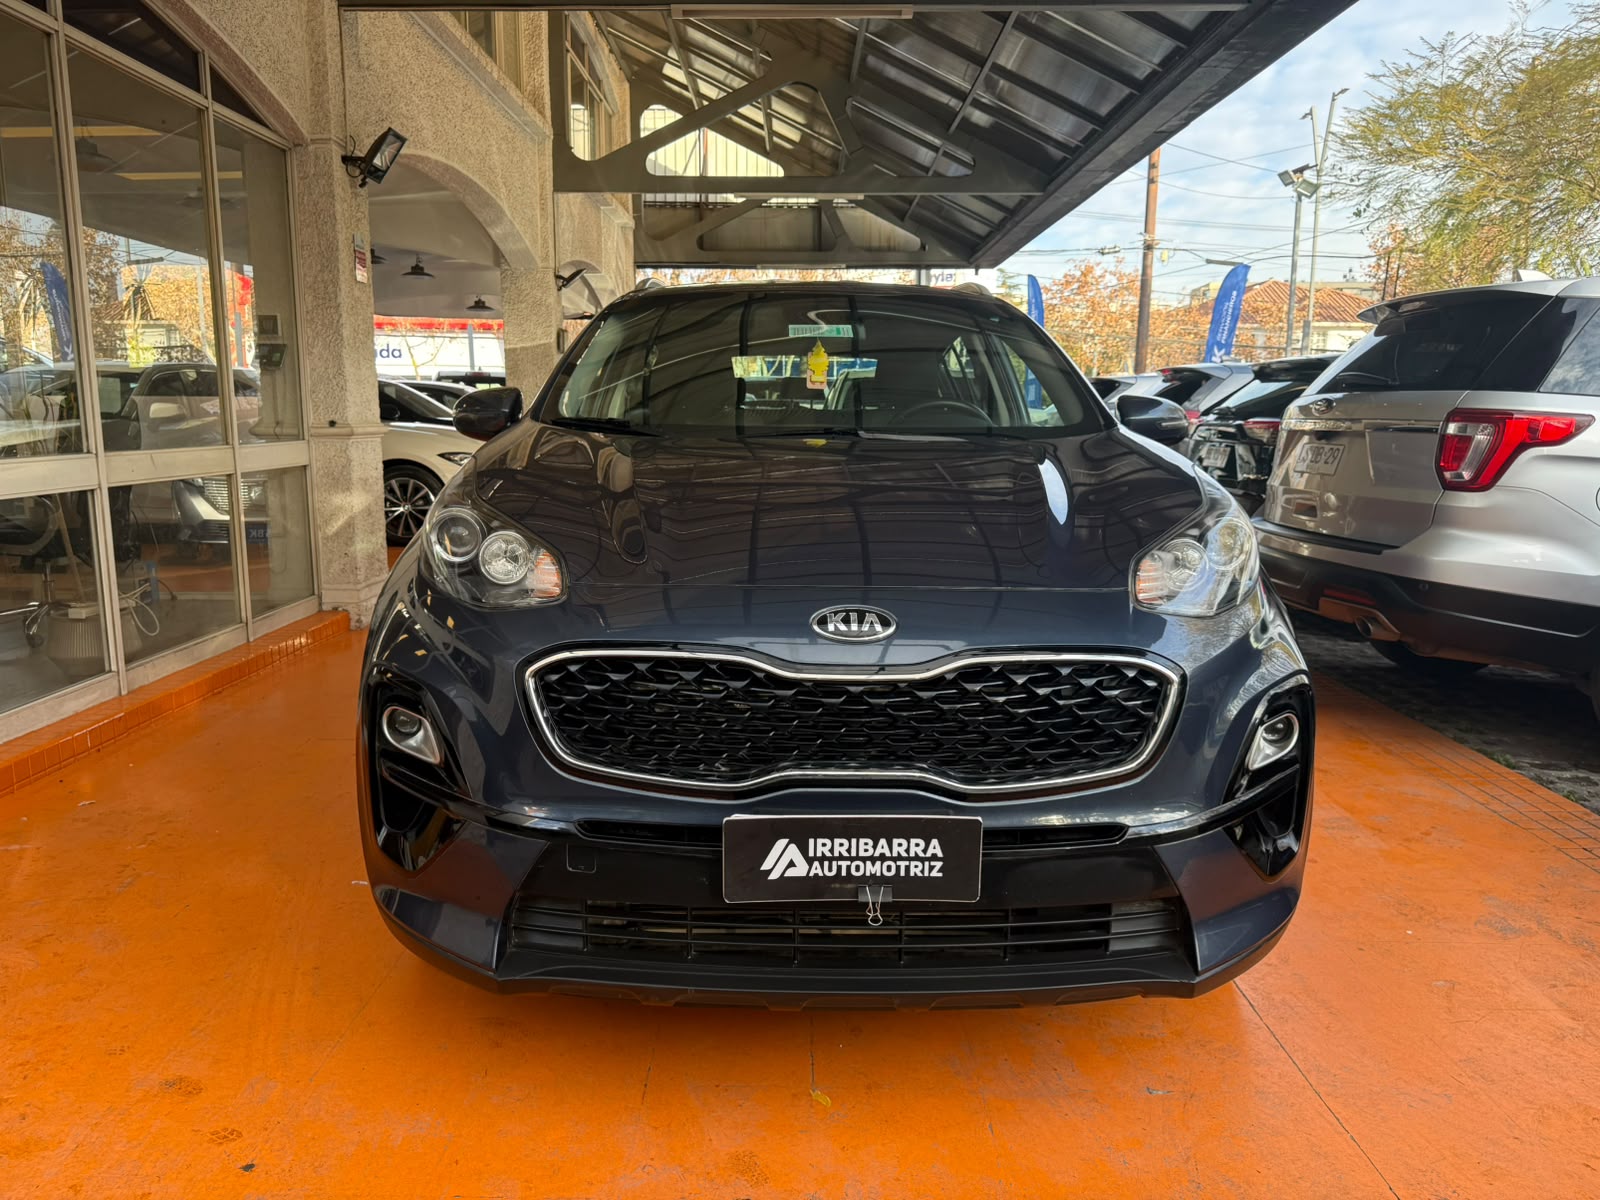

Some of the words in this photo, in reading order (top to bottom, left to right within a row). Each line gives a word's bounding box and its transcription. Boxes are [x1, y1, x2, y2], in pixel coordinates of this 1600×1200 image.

[826, 612, 884, 633] KIA
[807, 837, 944, 857] IRRIBARRA
[808, 860, 944, 878] AUTOMOTRIZ
